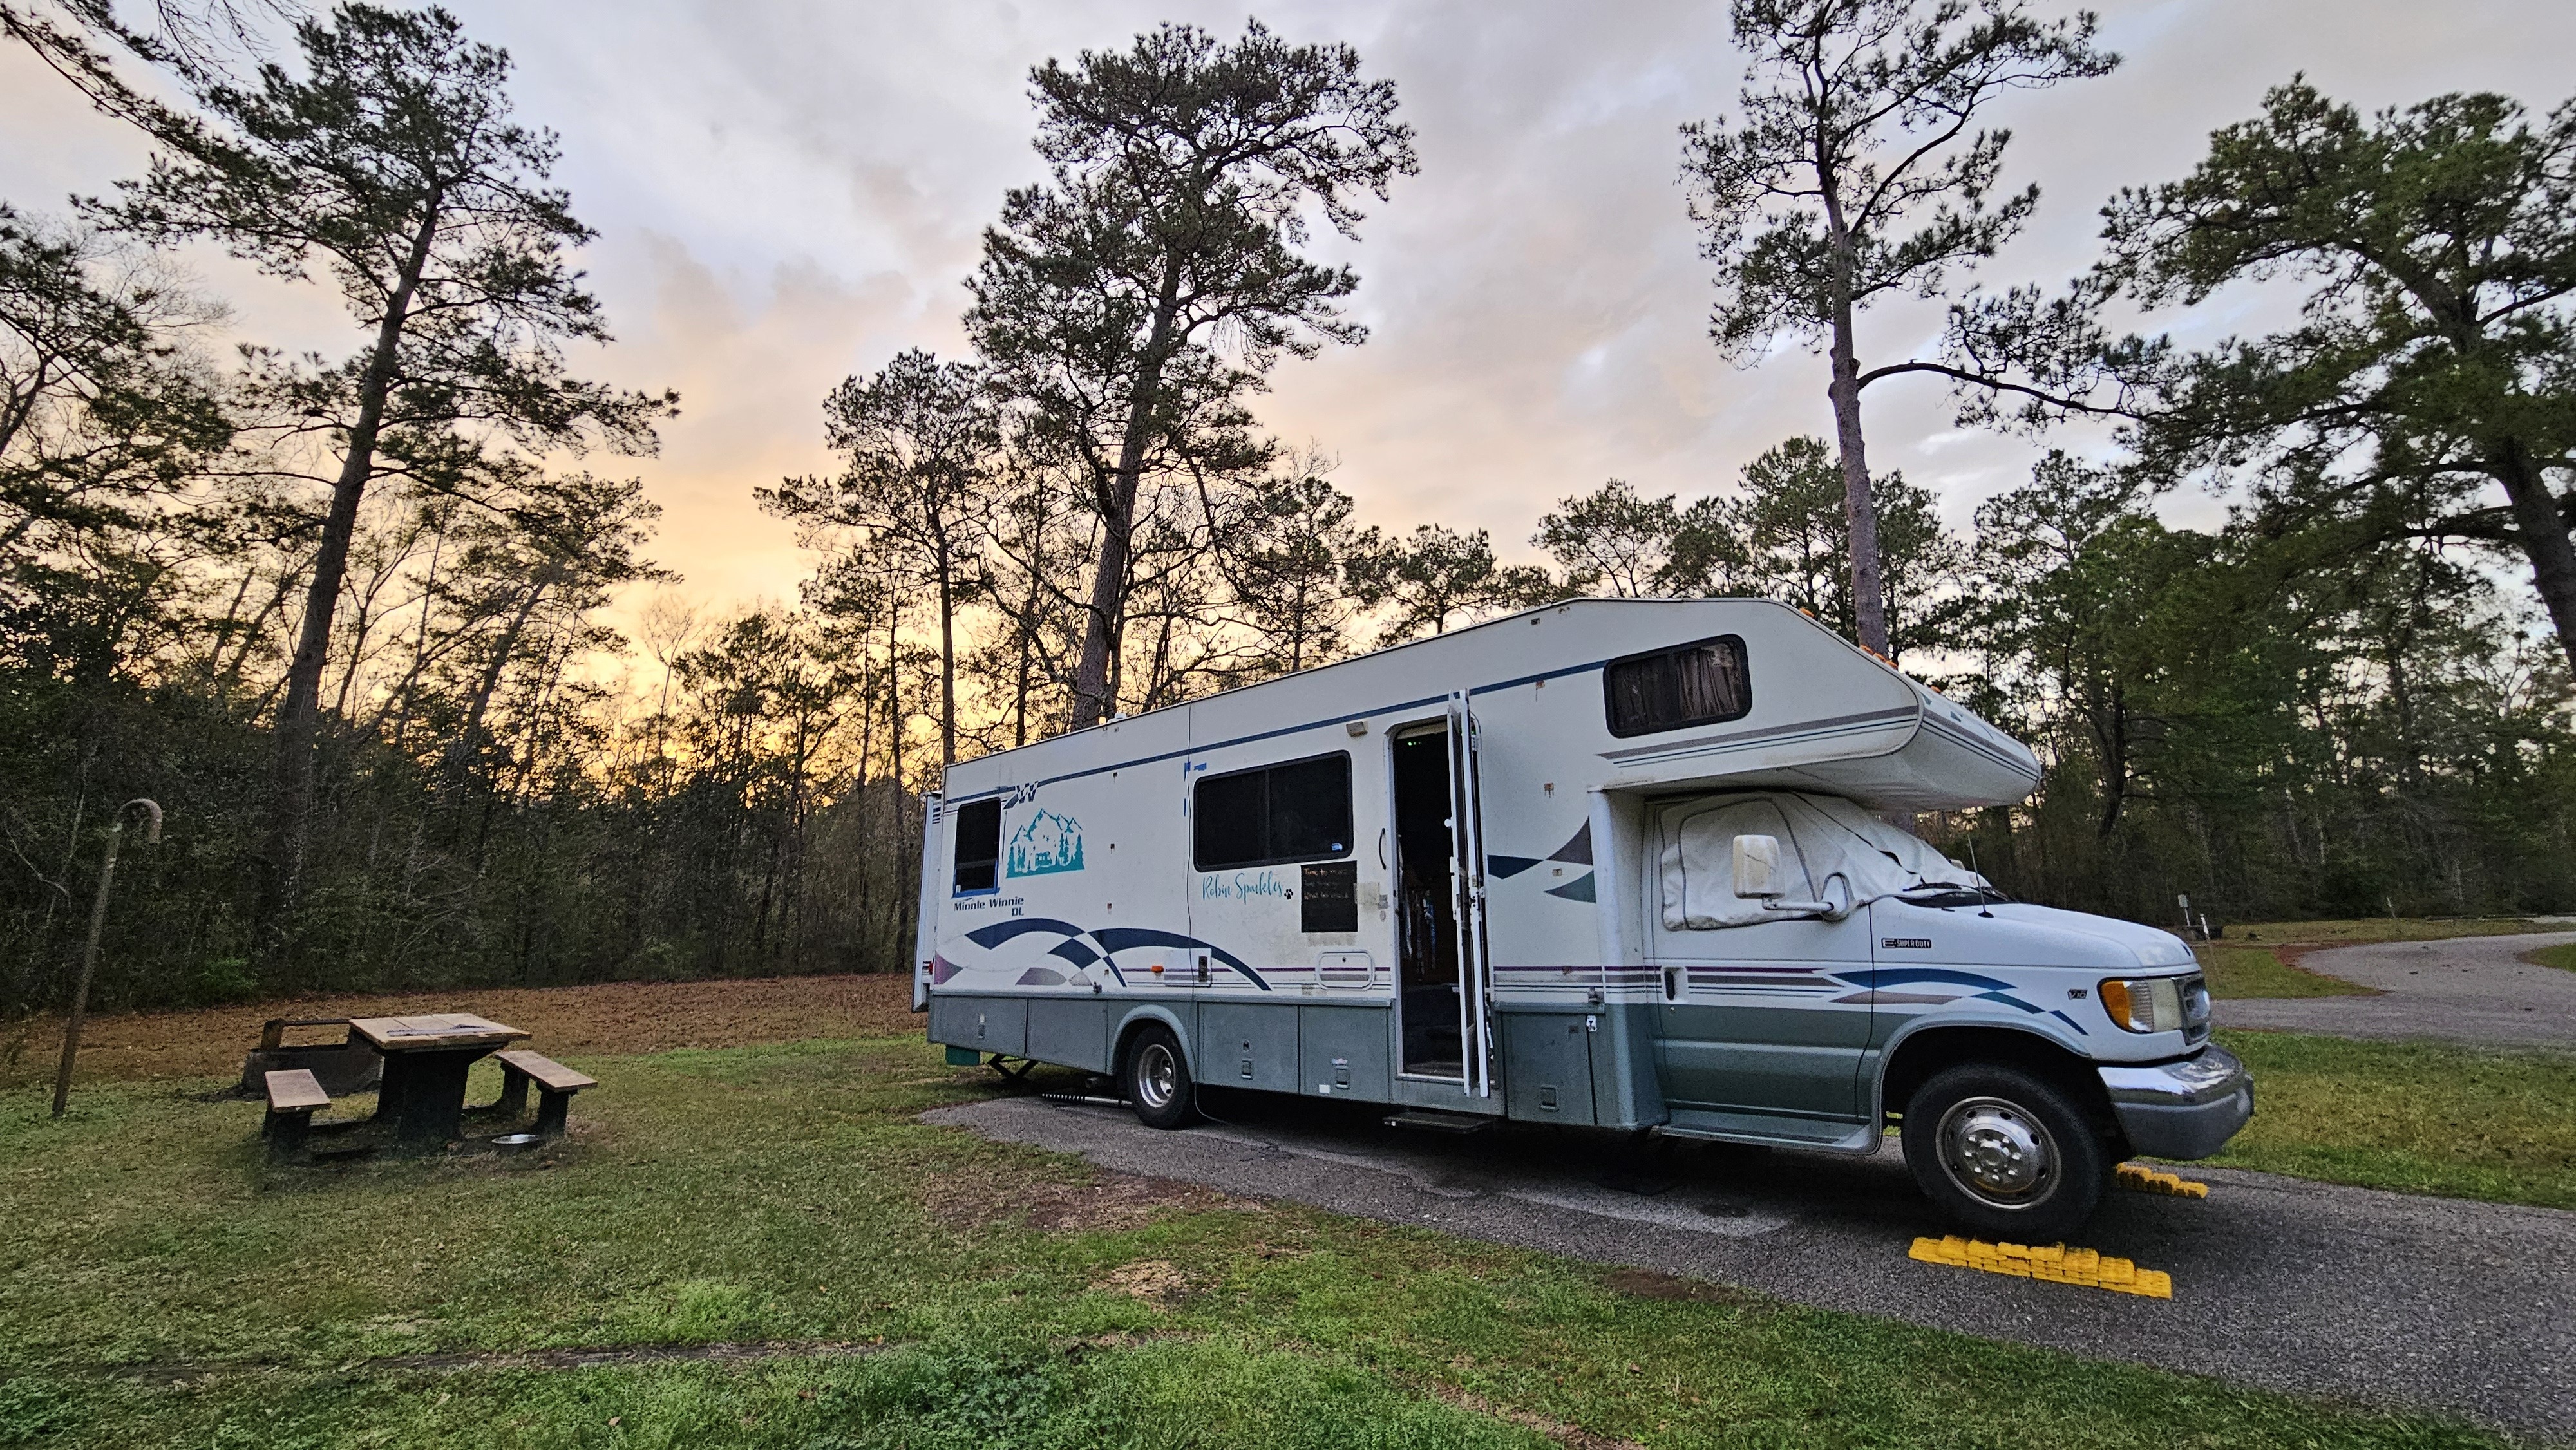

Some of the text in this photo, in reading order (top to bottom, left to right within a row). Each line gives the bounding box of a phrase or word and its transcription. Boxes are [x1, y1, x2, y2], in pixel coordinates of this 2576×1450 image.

[1202, 870, 1283, 905] Robin Sparkles
[954, 896, 1024, 911] Minnie Winnie
[1011, 907, 1024, 916] DL
[1915, 939, 1930, 948] DUTY
[2068, 991, 2087, 999] V10
